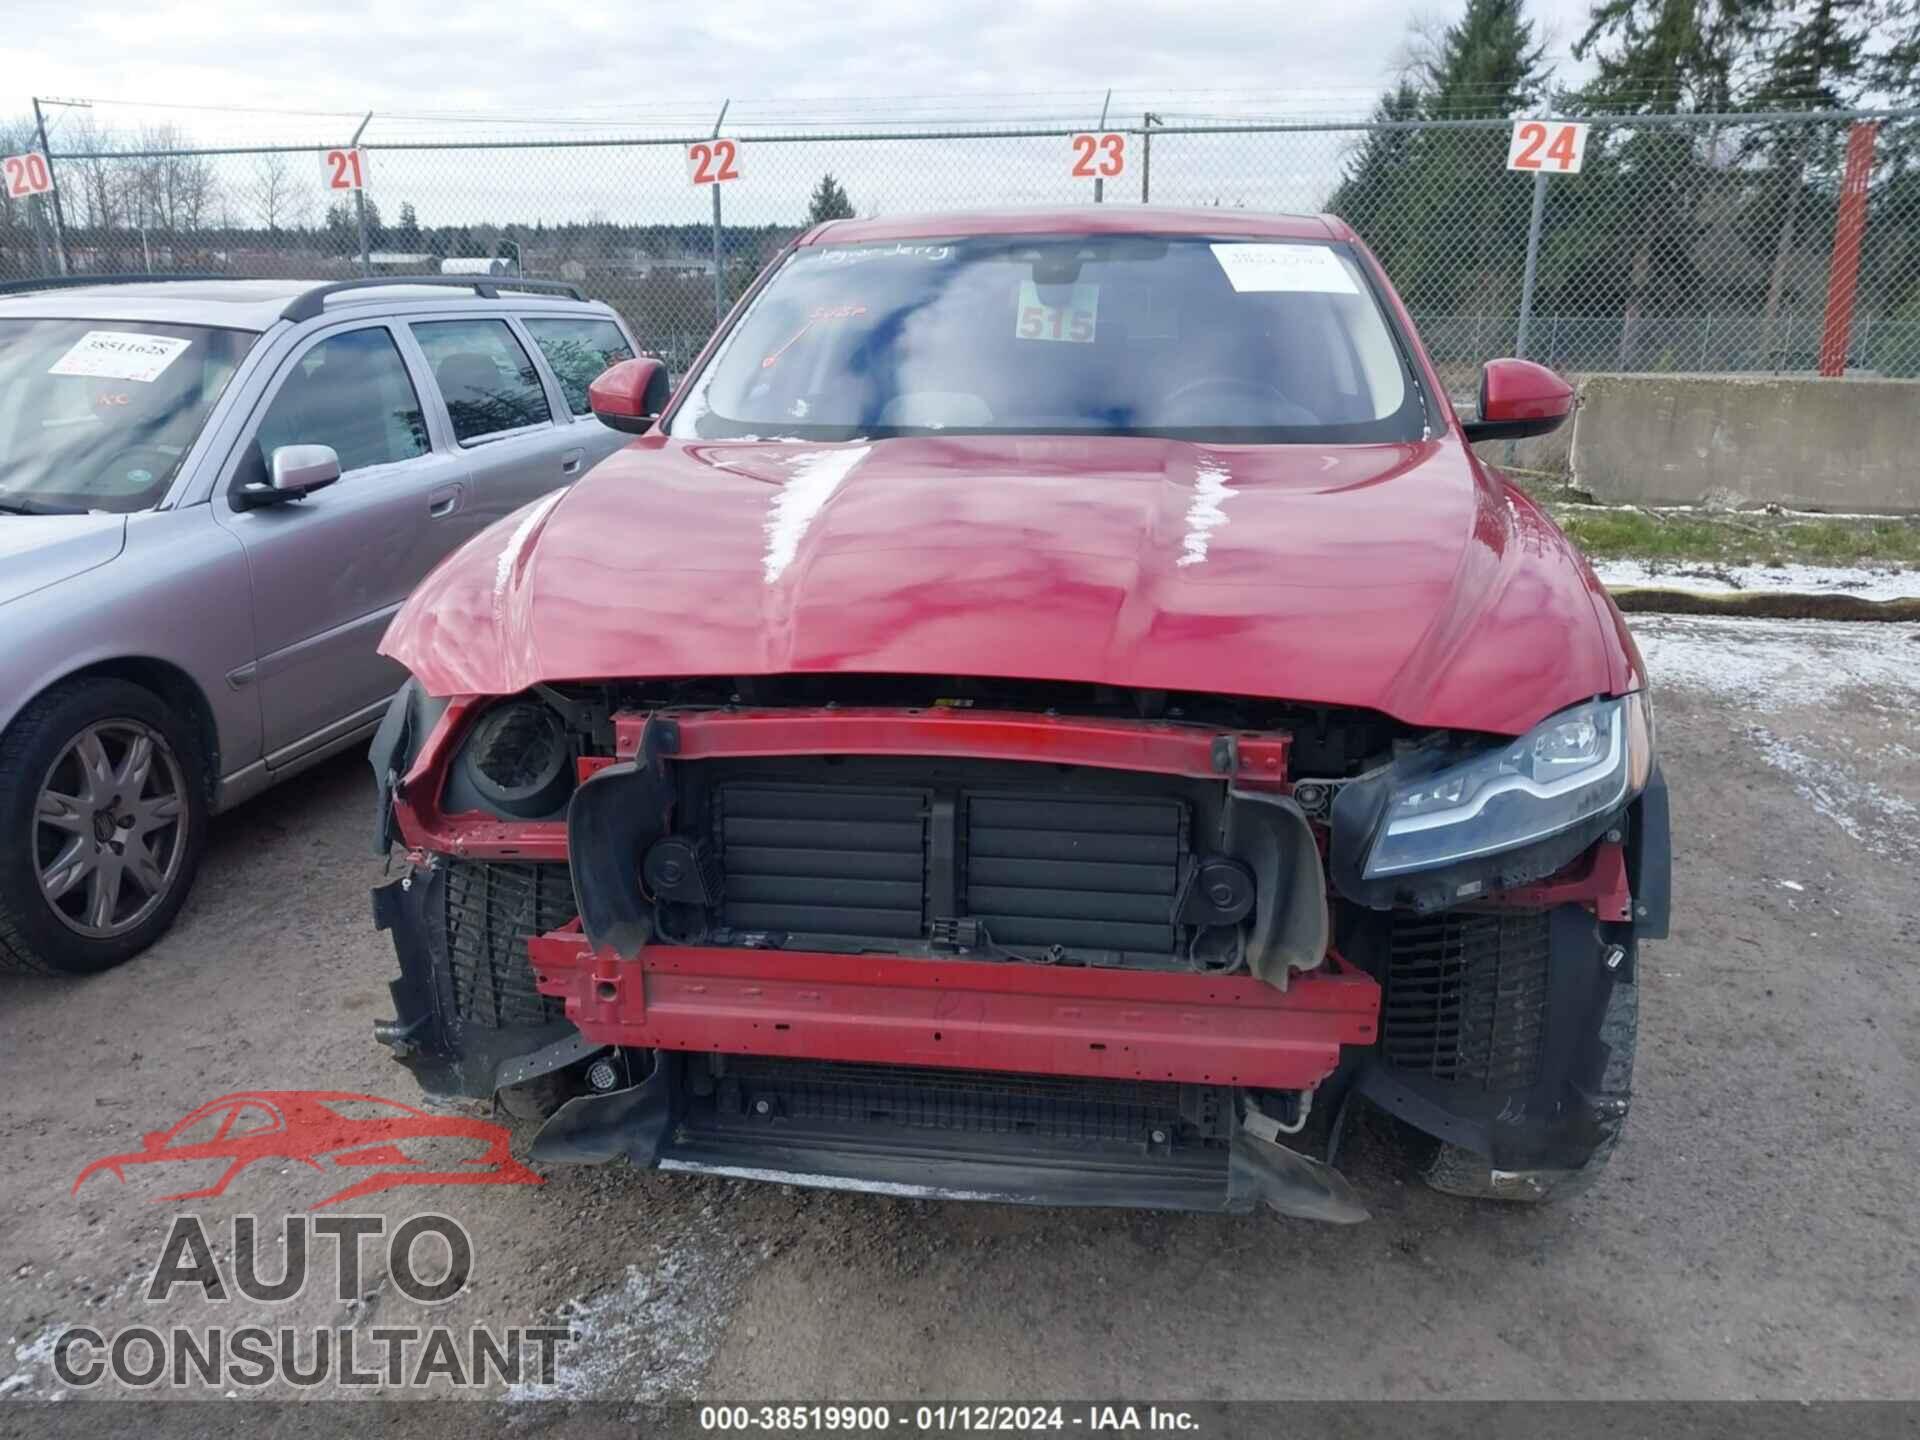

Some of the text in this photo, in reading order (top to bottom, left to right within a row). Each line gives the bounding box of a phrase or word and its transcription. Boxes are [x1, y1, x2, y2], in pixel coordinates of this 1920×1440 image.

[690, 141, 738, 184] 22
[1072, 134, 1124, 176] 23
[1514, 123, 1576, 170] 24
[6, 154, 48, 194] 20
[328, 150, 362, 188] 21
[1021, 306, 1094, 342] 515
